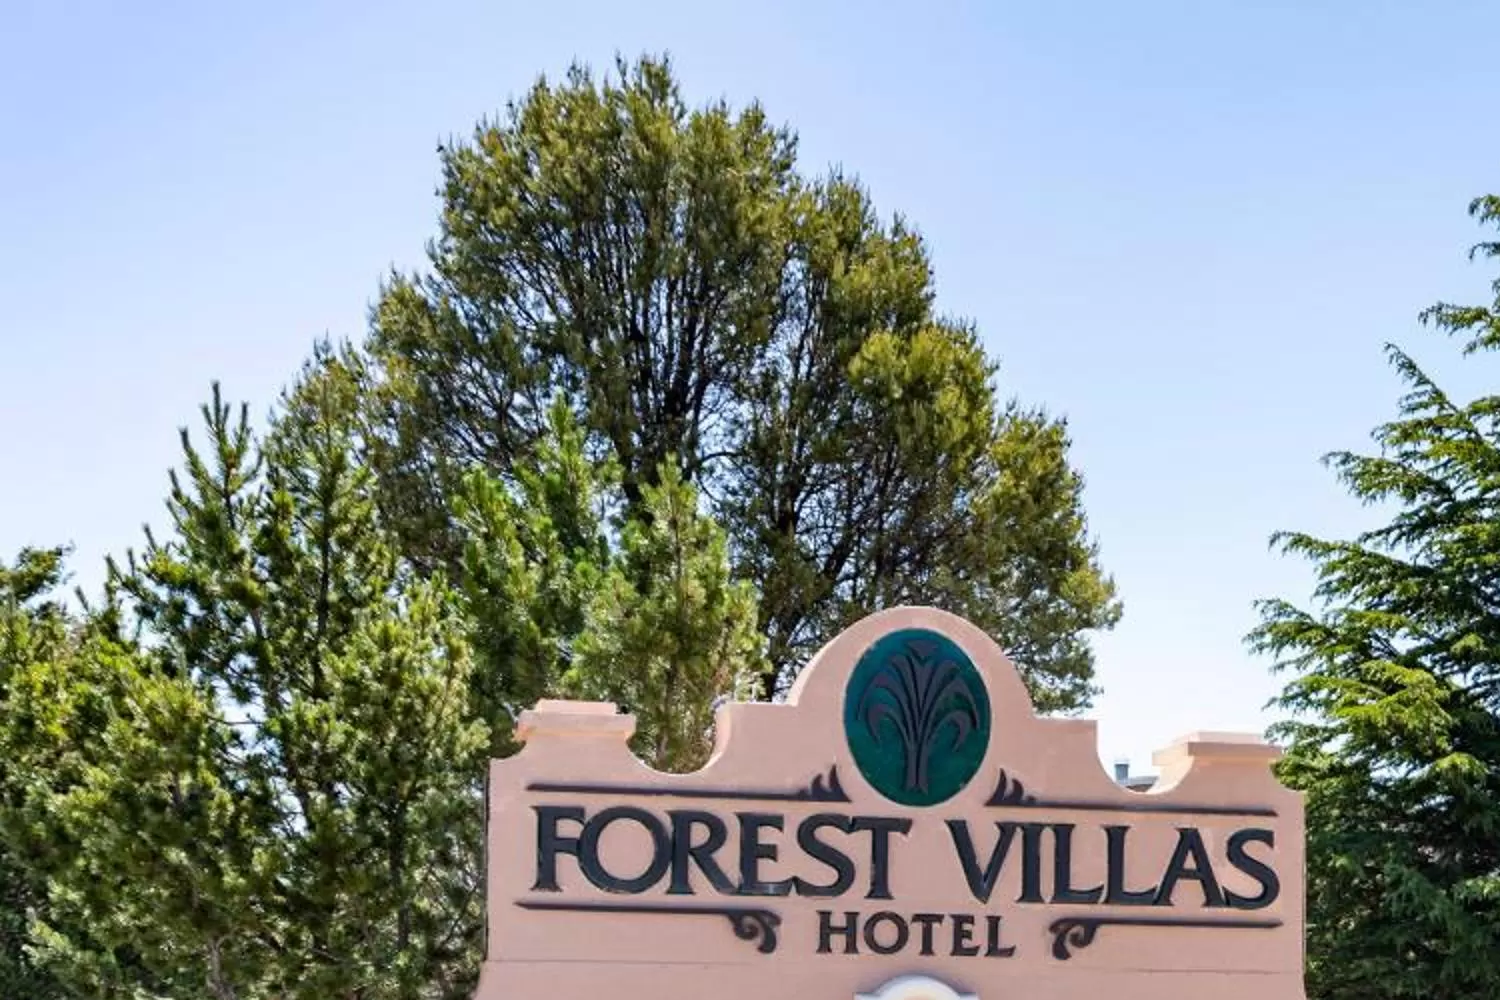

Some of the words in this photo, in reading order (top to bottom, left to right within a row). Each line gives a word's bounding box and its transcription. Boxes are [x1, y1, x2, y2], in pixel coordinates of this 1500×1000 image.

[531, 804, 913, 900] FOREST
[944, 818, 1281, 911] VILLAS
[815, 910, 1017, 957] HOTEL
